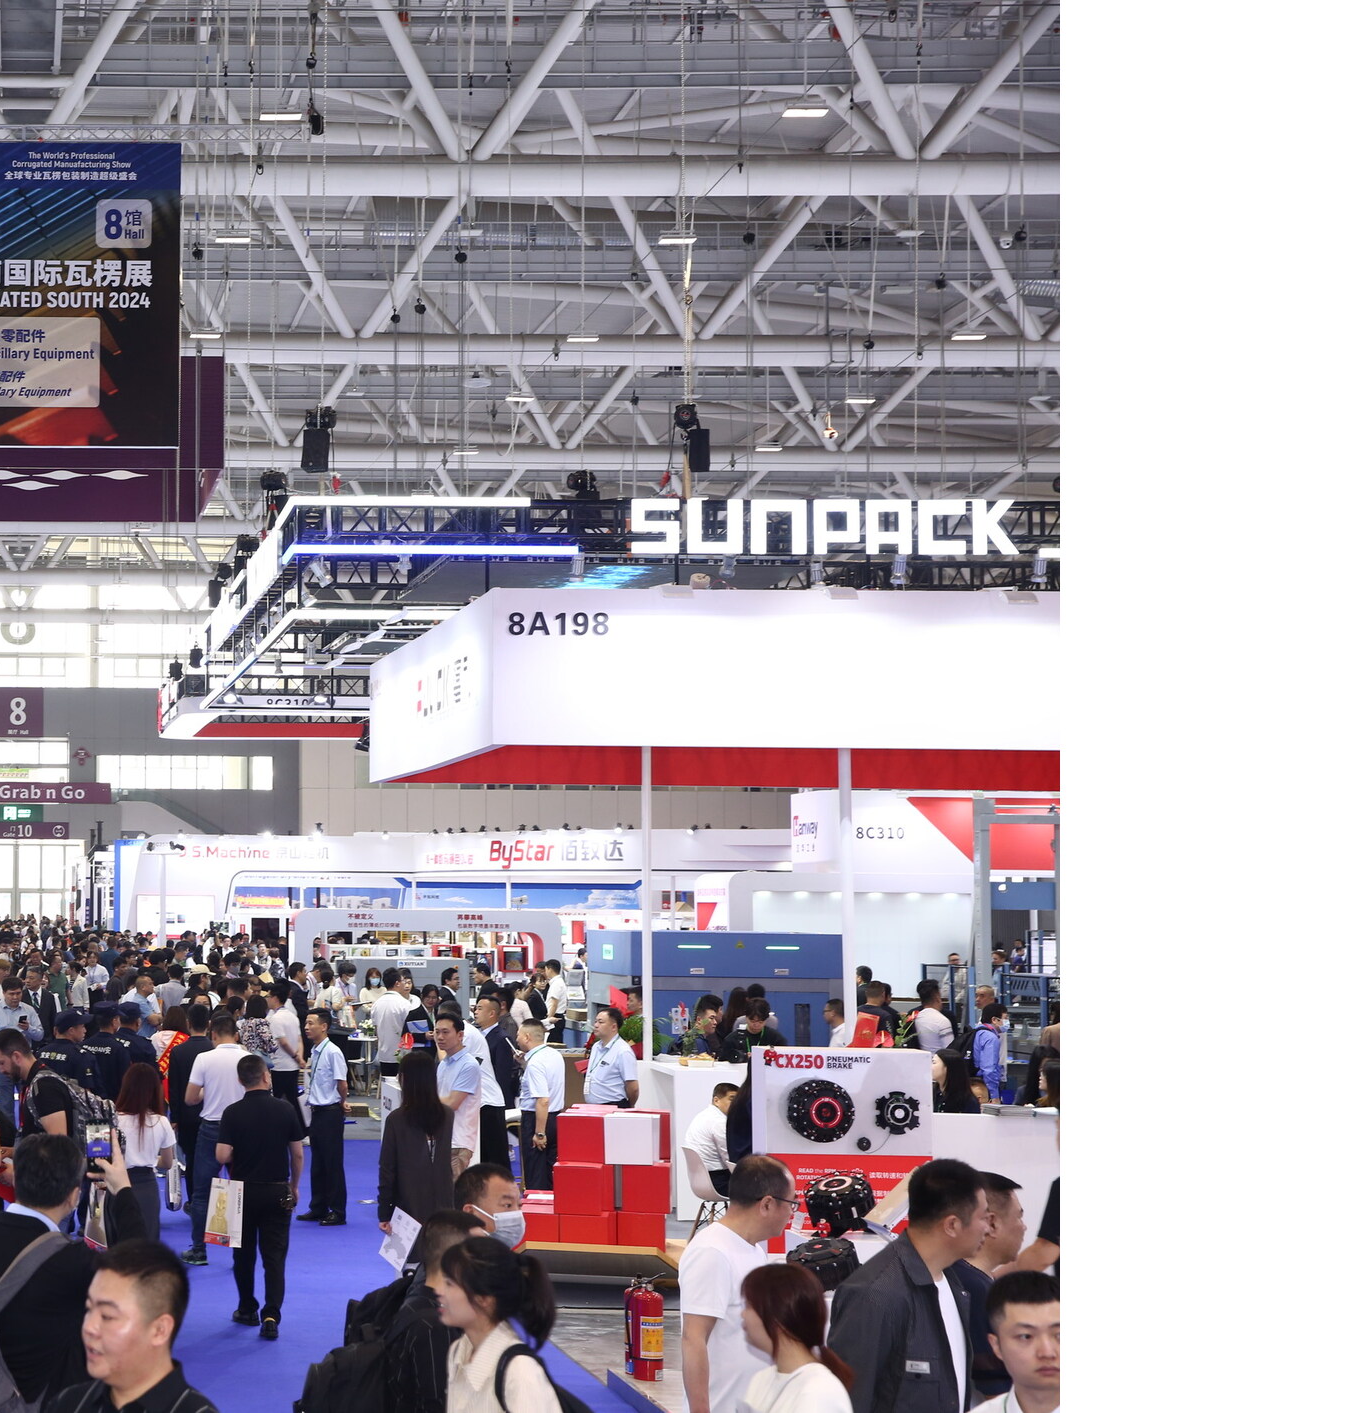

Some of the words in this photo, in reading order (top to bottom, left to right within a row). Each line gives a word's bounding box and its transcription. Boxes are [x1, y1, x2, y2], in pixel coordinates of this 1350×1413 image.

[12, 160, 53, 169] Corrugated
[104, 208, 123, 240] 8
[124, 209, 142, 227] 馆
[124, 229, 145, 240] Hall
[46, 291, 104, 309] SOUTH
[108, 292, 151, 309] 2024
[33, 347, 95, 361] Equipment
[18, 386, 72, 398] Equipment
[631, 497, 1019, 555] SUNPACK
[508, 611, 609, 636] 8A198
[9, 697, 27, 726] 8
[61, 785, 86, 800] Go
[17, 824, 33, 837] 10
[855, 826, 905, 839] 8C310
[490, 840, 555, 869] ByStar
[561, 839, 624, 861] 佰致达
[775, 1054, 824, 1069] CX250
[826, 1062, 853, 1070] BRAKE
